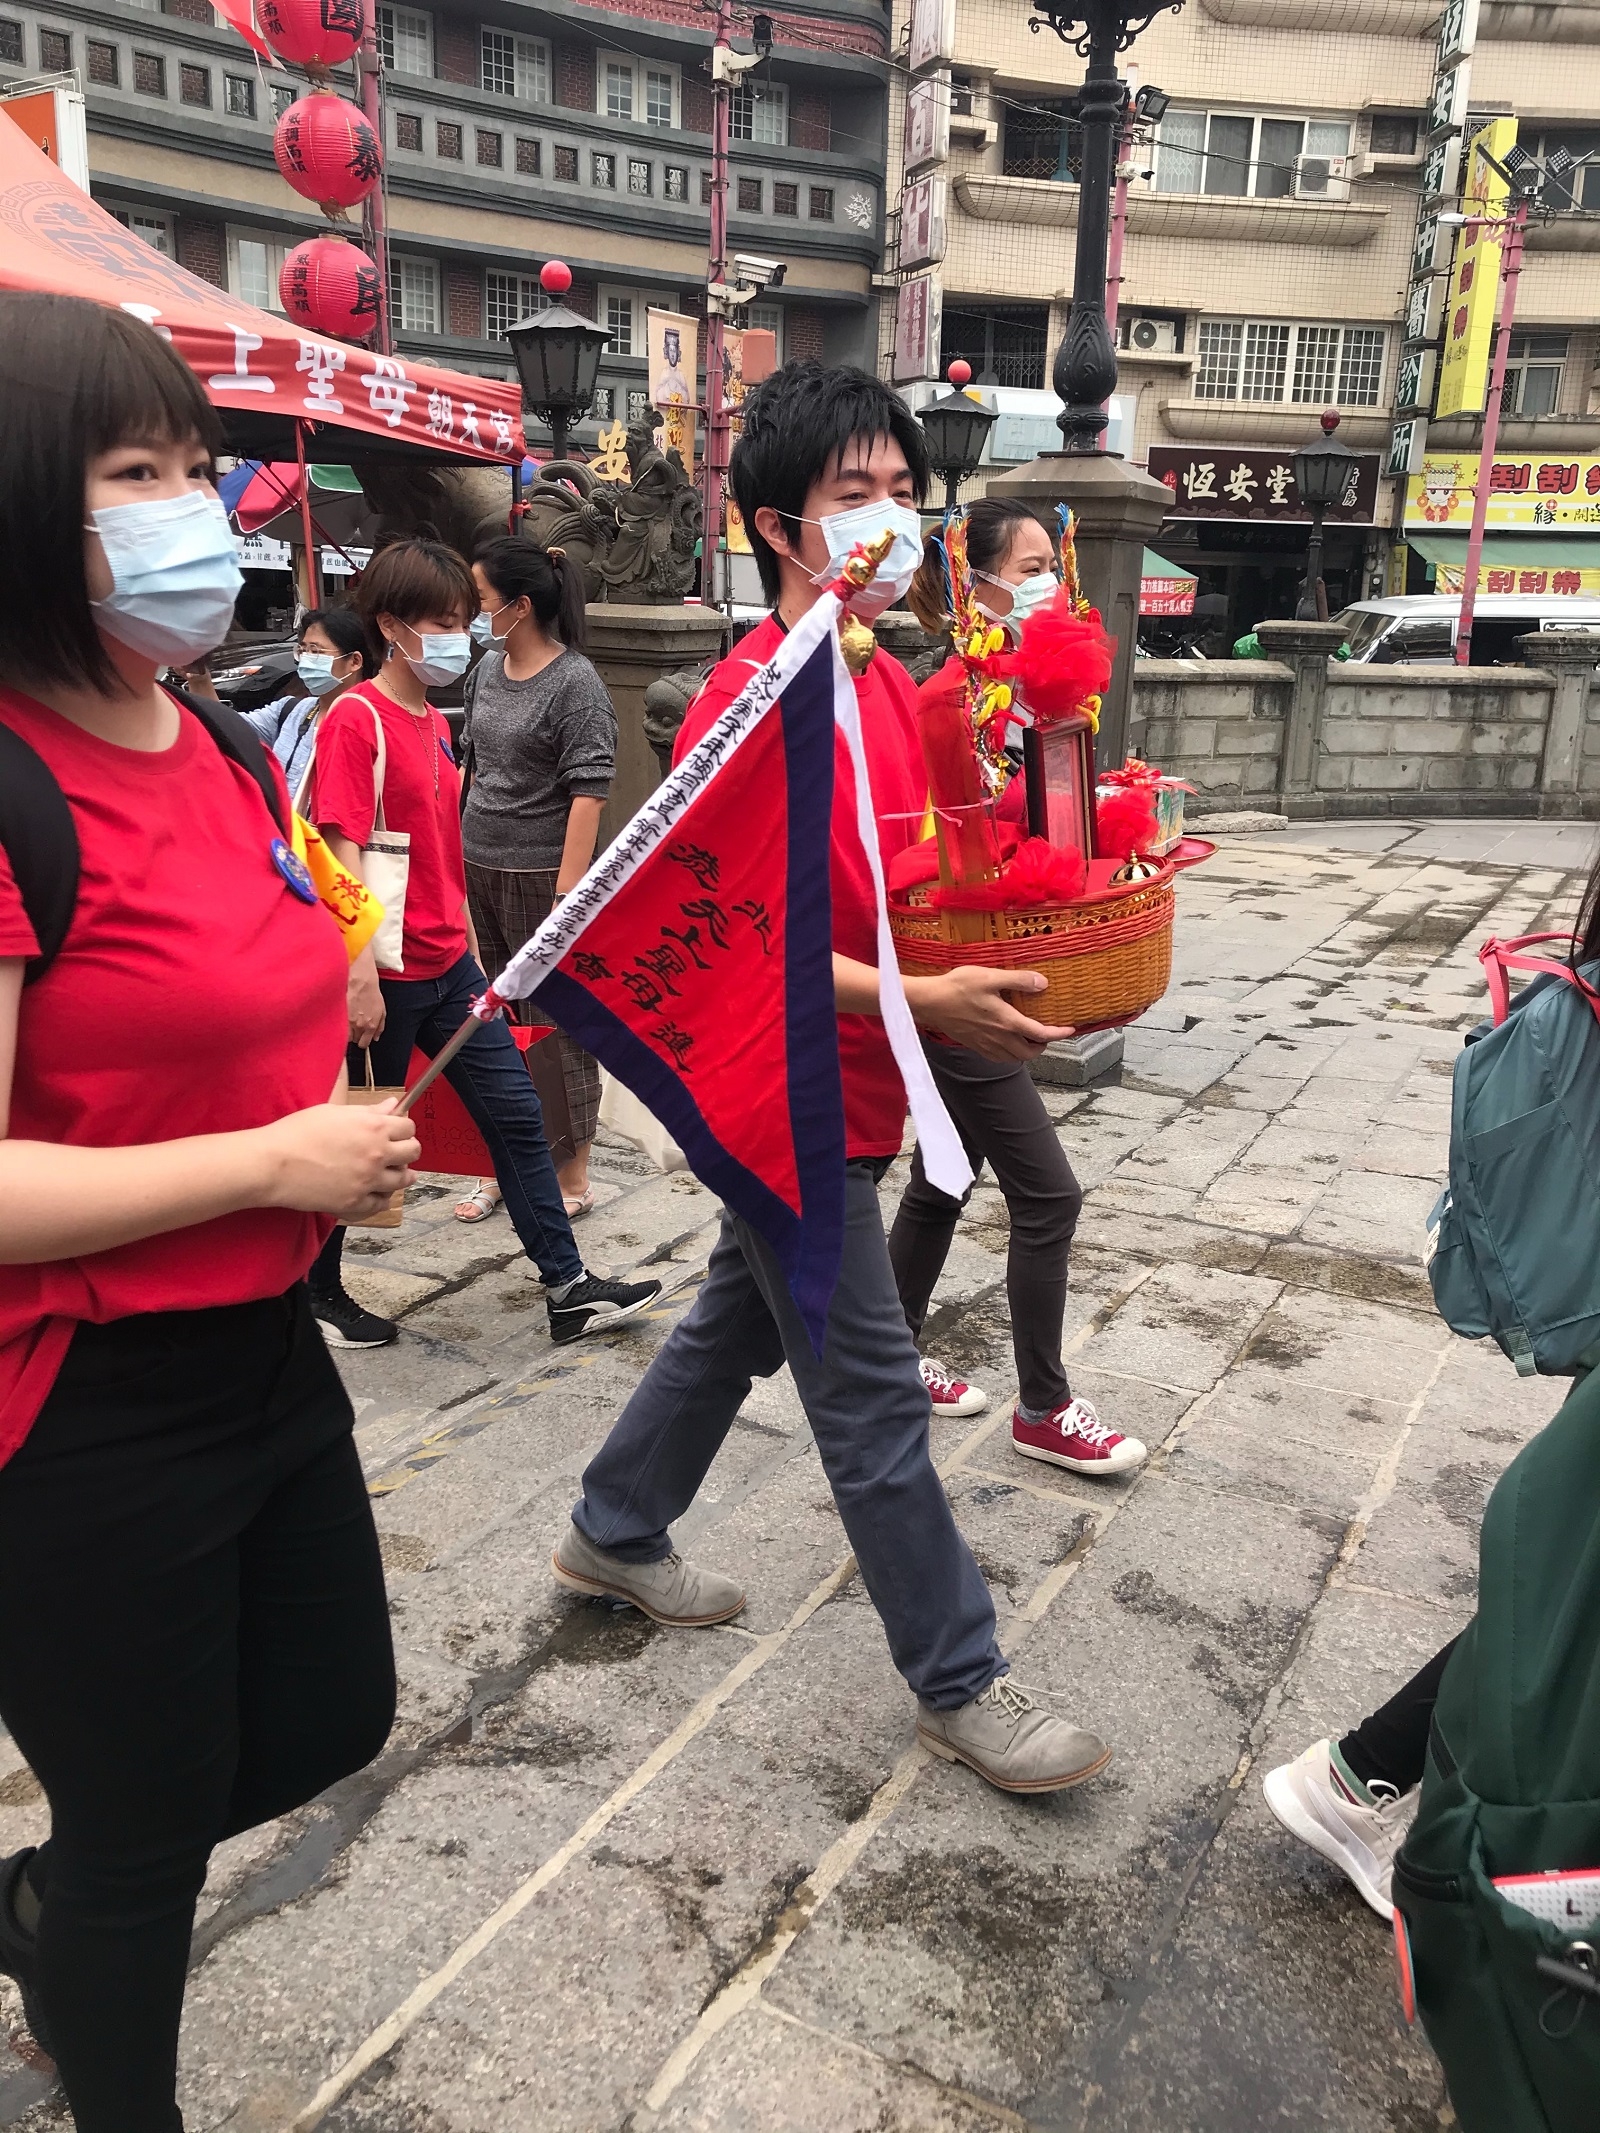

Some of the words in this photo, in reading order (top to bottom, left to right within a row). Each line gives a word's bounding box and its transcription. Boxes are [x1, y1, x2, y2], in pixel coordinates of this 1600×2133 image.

[284, 113, 309, 174] 風調雨順
[345, 121, 382, 182] 泰
[291, 254, 313, 313] 風調雨順
[350, 266, 384, 316] 民
[425, 387, 515, 456] 朝天宮
[587, 419, 632, 484] 安
[666, 392, 686, 455] 歡迎
[1182, 461, 1295, 504] 恆安堂
[1487, 570, 1581, 595] 刮刮樂
[620, 898, 731, 1016] 天上聖母
[1566, 1898, 1583, 1916] L
